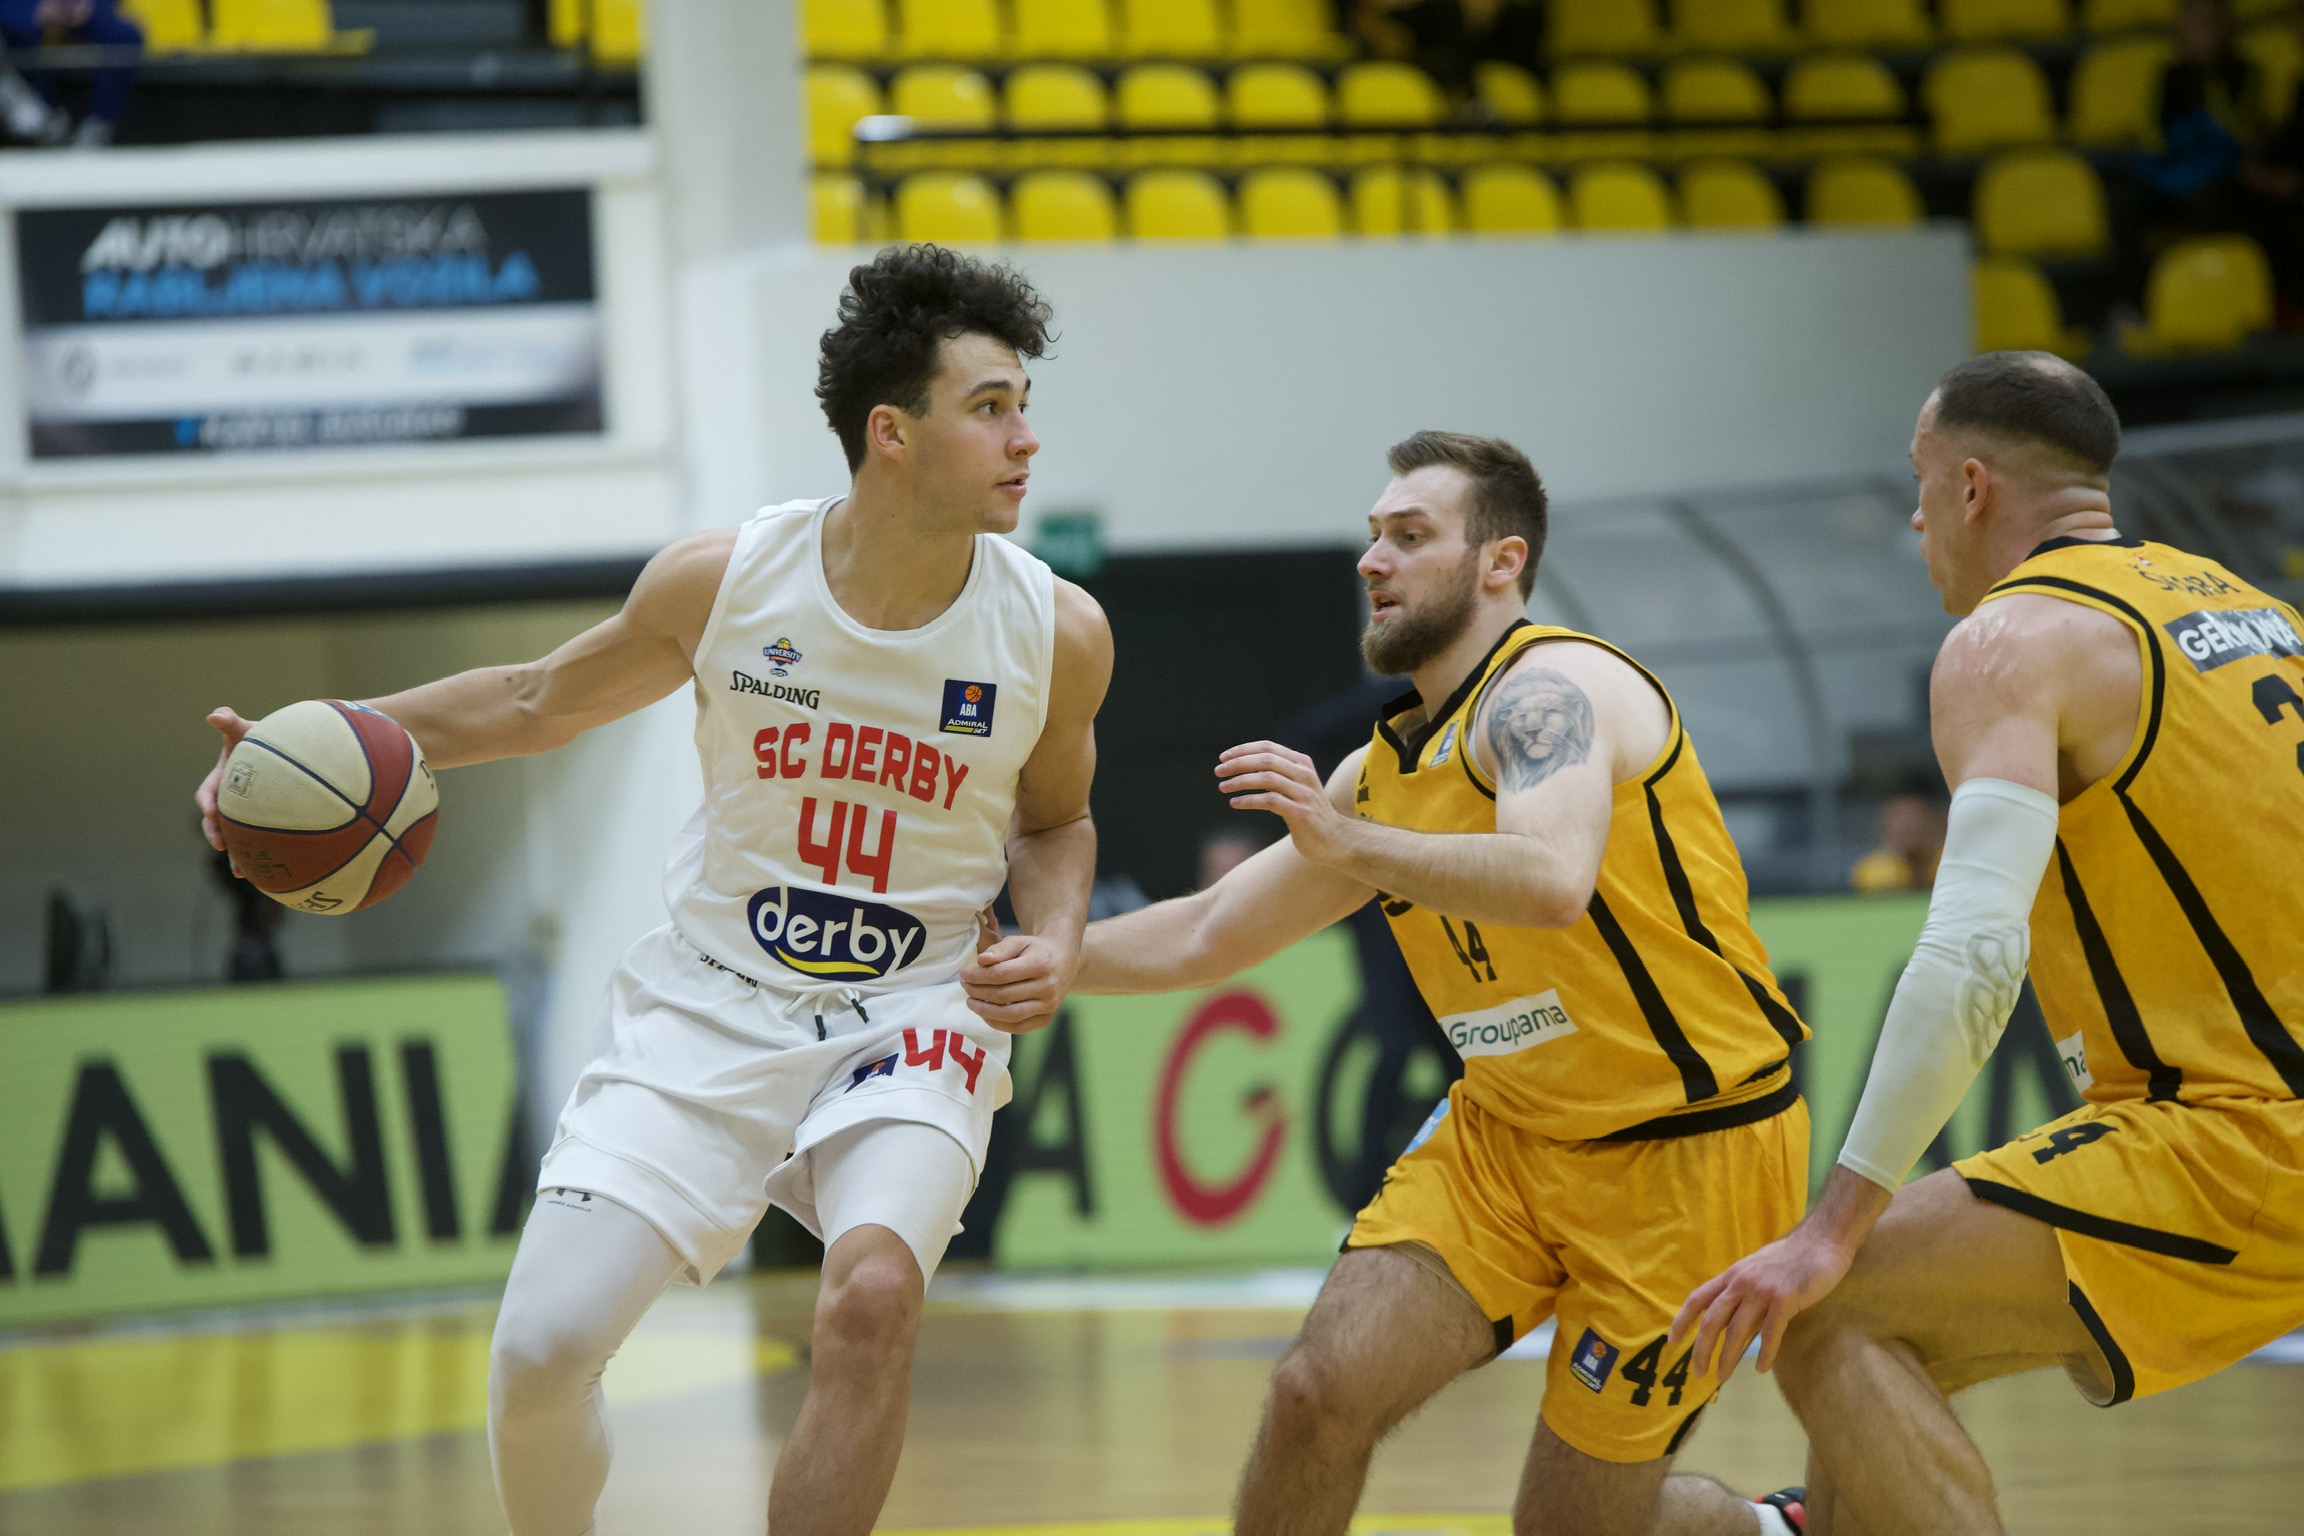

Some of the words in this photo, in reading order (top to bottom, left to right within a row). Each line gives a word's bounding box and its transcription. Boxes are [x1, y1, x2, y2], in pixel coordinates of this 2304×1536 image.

[764, 648, 800, 661] UNIVERSITY
[730, 670, 820, 710] SPALDING
[959, 703, 977, 717] ABA
[947, 718, 988, 729] ADMIRAL
[754, 722, 811, 780] SC
[820, 722, 969, 811] DERBY
[797, 796, 898, 894] 44
[756, 886, 920, 975] derby
[1449, 1004, 1568, 1048] Groupama
[902, 1028, 987, 1096] 44
[1620, 1333, 1695, 1407] 44
